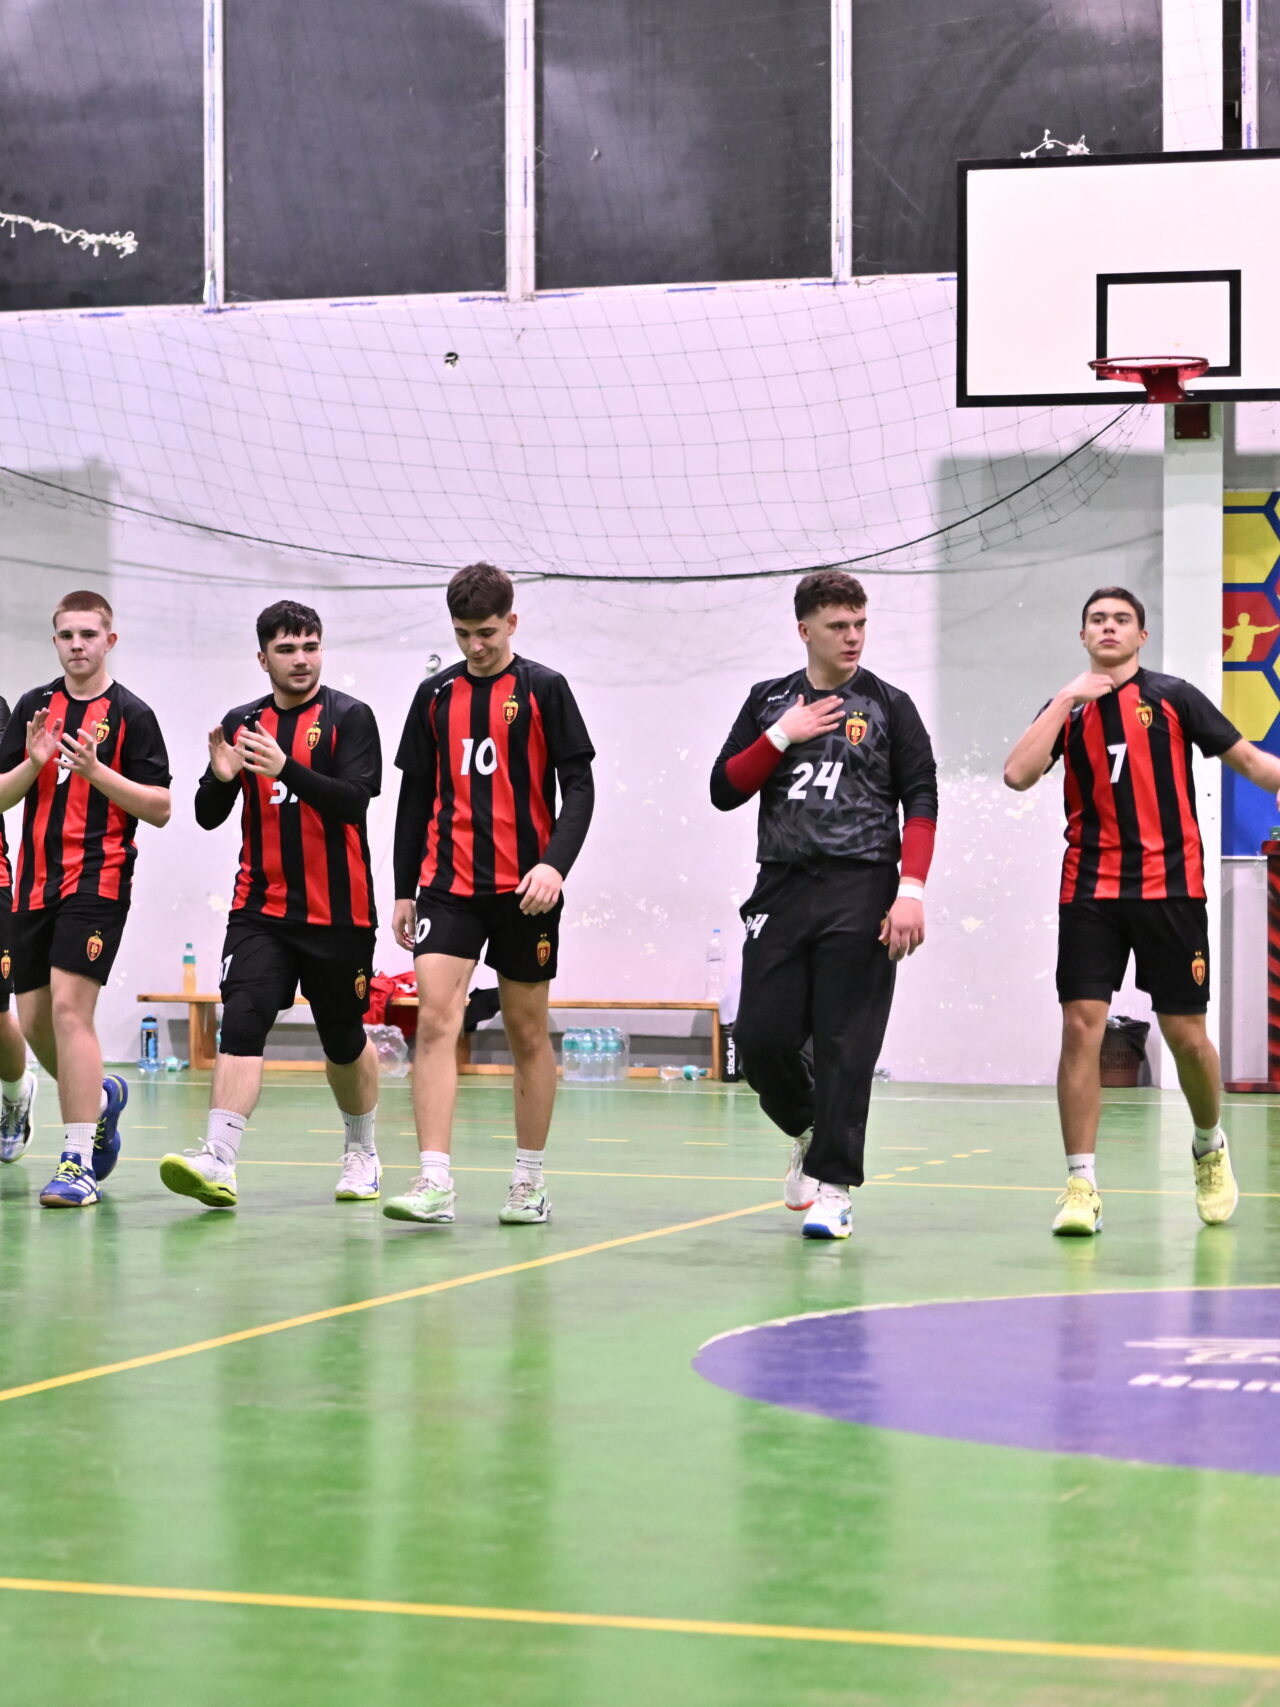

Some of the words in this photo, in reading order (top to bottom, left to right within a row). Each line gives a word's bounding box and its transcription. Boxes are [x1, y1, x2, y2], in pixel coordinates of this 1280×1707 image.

[460, 737, 498, 776] 10
[1107, 743, 1128, 784] 7
[787, 761, 844, 800] 24
